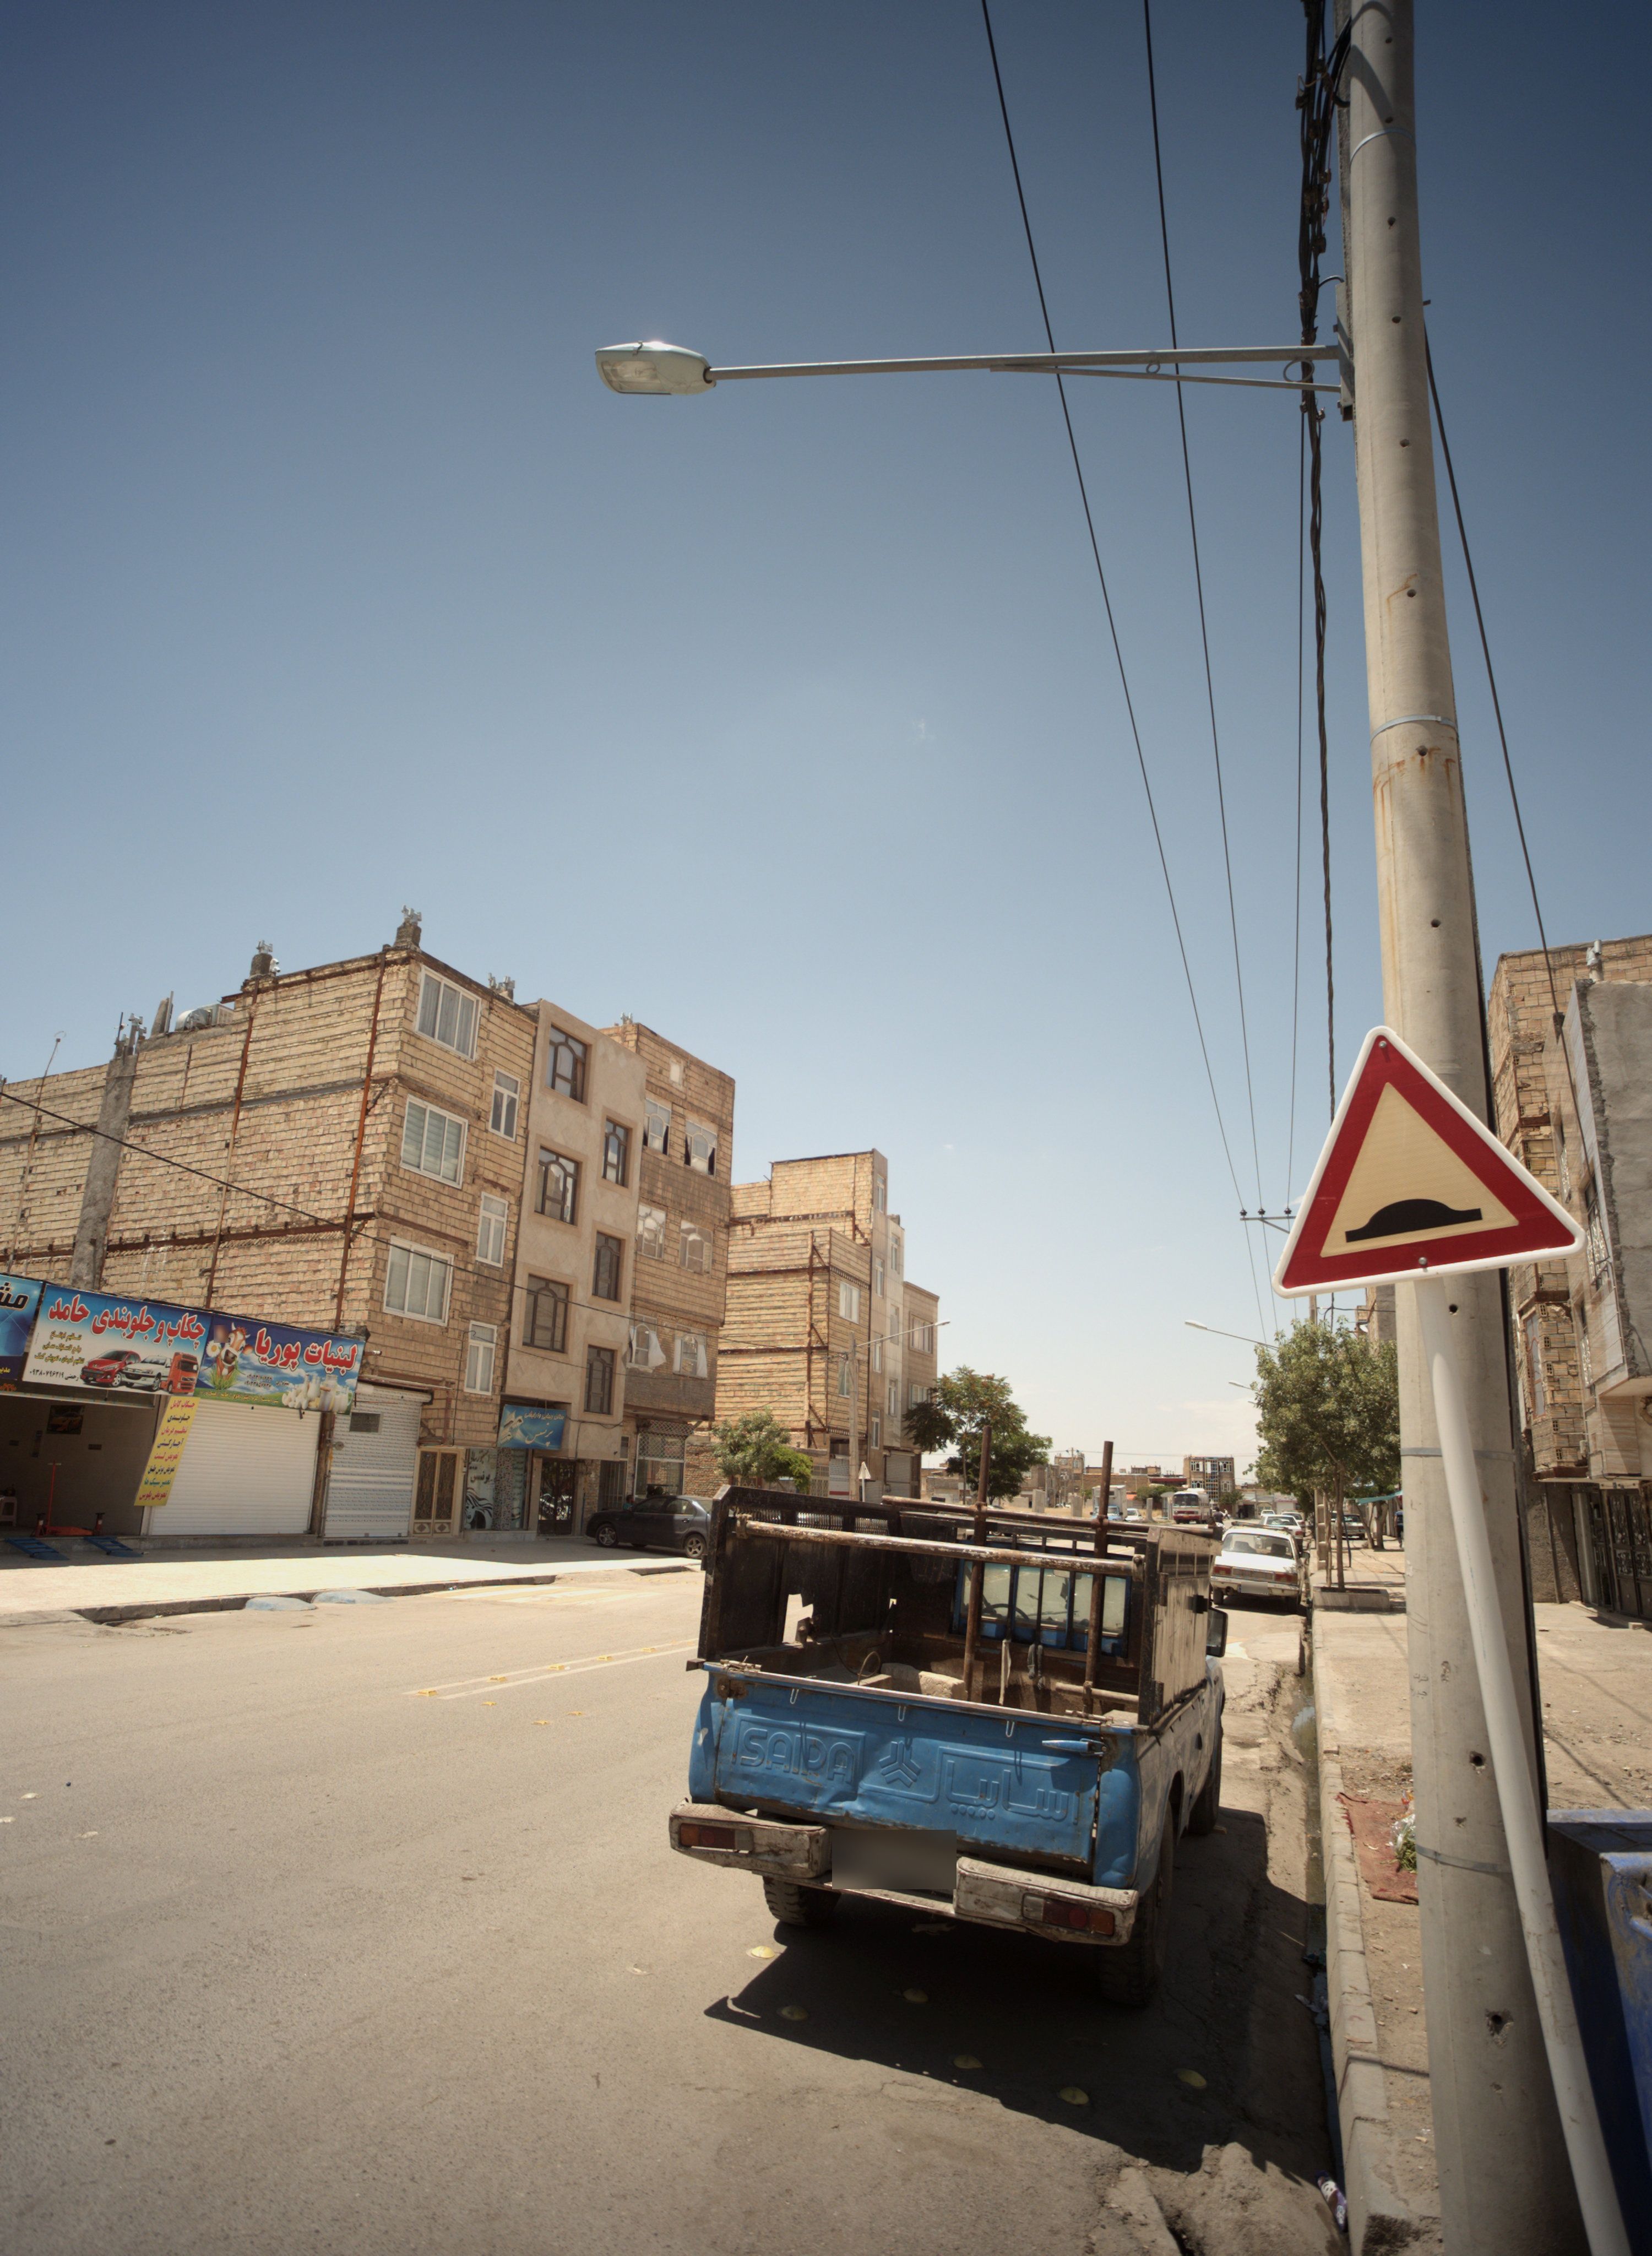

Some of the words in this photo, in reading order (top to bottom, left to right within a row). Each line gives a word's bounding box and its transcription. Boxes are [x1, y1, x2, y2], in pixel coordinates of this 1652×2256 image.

[48, 1294, 90, 1322] حامد
[91, 1305, 156, 1341] جلوبندی
[154, 1320, 165, 1343] و
[166, 1313, 205, 1351] چکاپ
[255, 1327, 301, 1371] پوریا
[304, 1340, 357, 1375] لبنیات
[167, 1413, 191, 1423] جلوبندی
[170, 1400, 182, 1409] کامل
[740, 1727, 855, 1783] SAIPA
[945, 1760, 1069, 1822] سایپا
